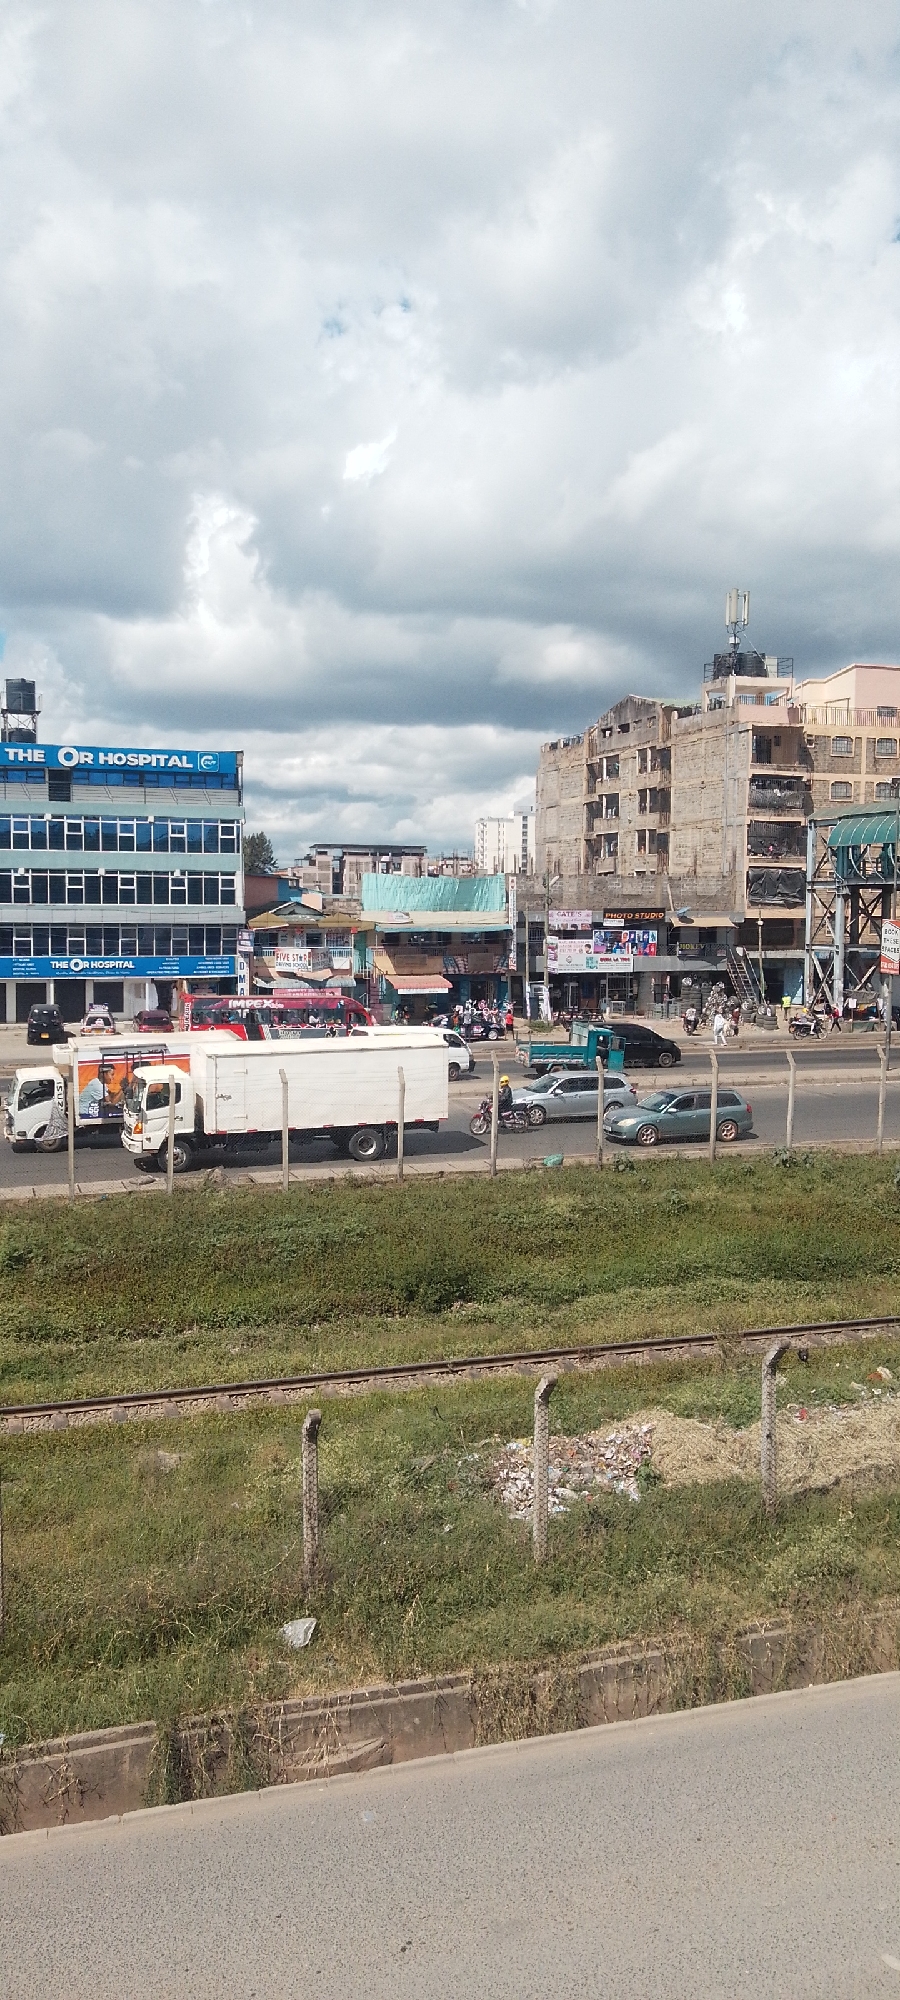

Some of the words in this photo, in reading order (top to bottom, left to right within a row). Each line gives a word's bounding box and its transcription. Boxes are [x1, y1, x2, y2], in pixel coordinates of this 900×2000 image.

[4, 748, 45, 763] THE
[57, 746, 94, 767] OR
[98, 752, 194, 769] HOSPITAL
[275, 953, 290, 962] FIVE
[50, 961, 69, 969] THE
[90, 961, 135, 969] HOSPITAL
[228, 999, 273, 1009] IMPEX
[56, 1081, 65, 1111] ISUZ
